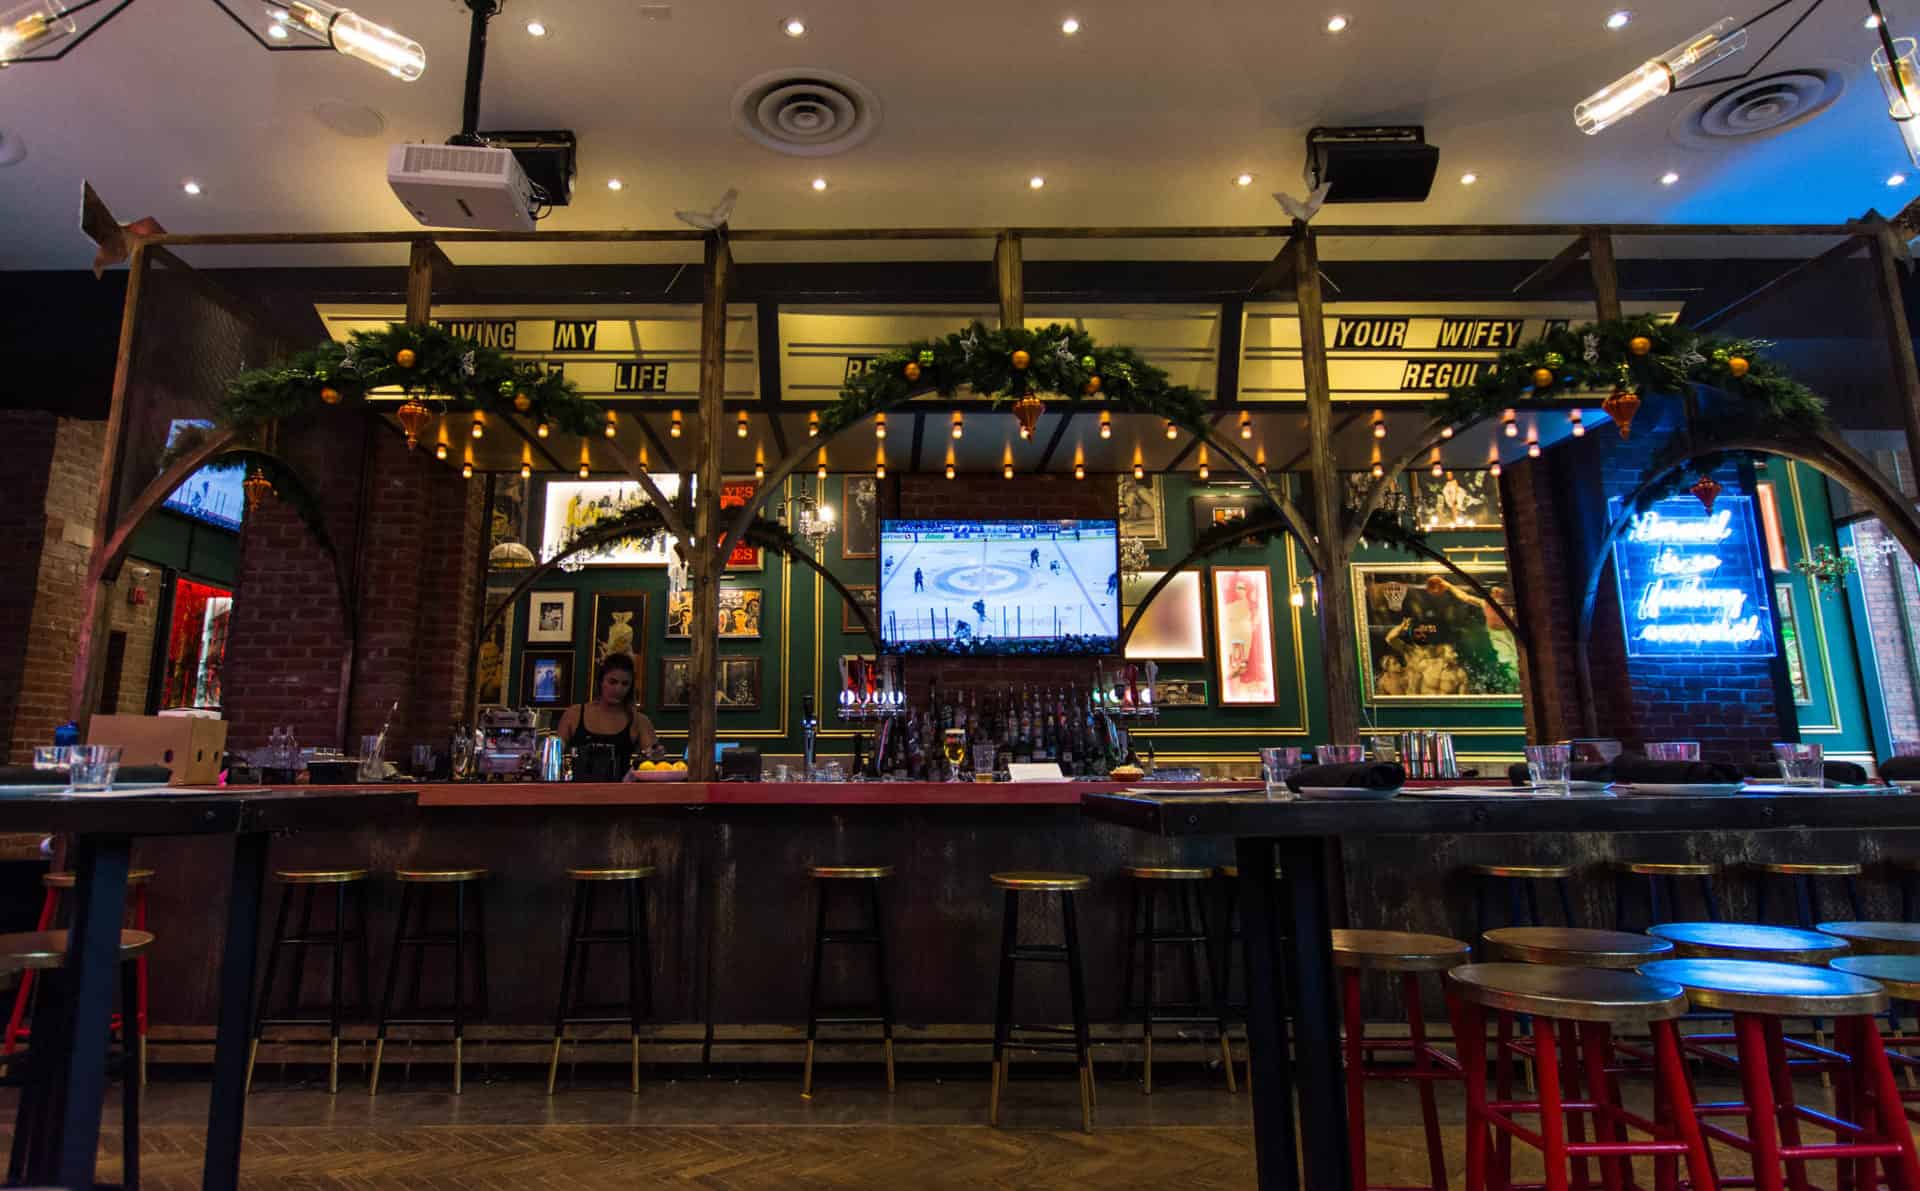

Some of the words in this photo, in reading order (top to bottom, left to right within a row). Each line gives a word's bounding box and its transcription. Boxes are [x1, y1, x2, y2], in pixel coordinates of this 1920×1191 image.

[555, 322, 596, 349] MY
[1338, 320, 1408, 347] YOUR
[1440, 320, 1521, 347] WIFEY
[615, 364, 668, 391] LIFE
[724, 486, 754, 498] YES
